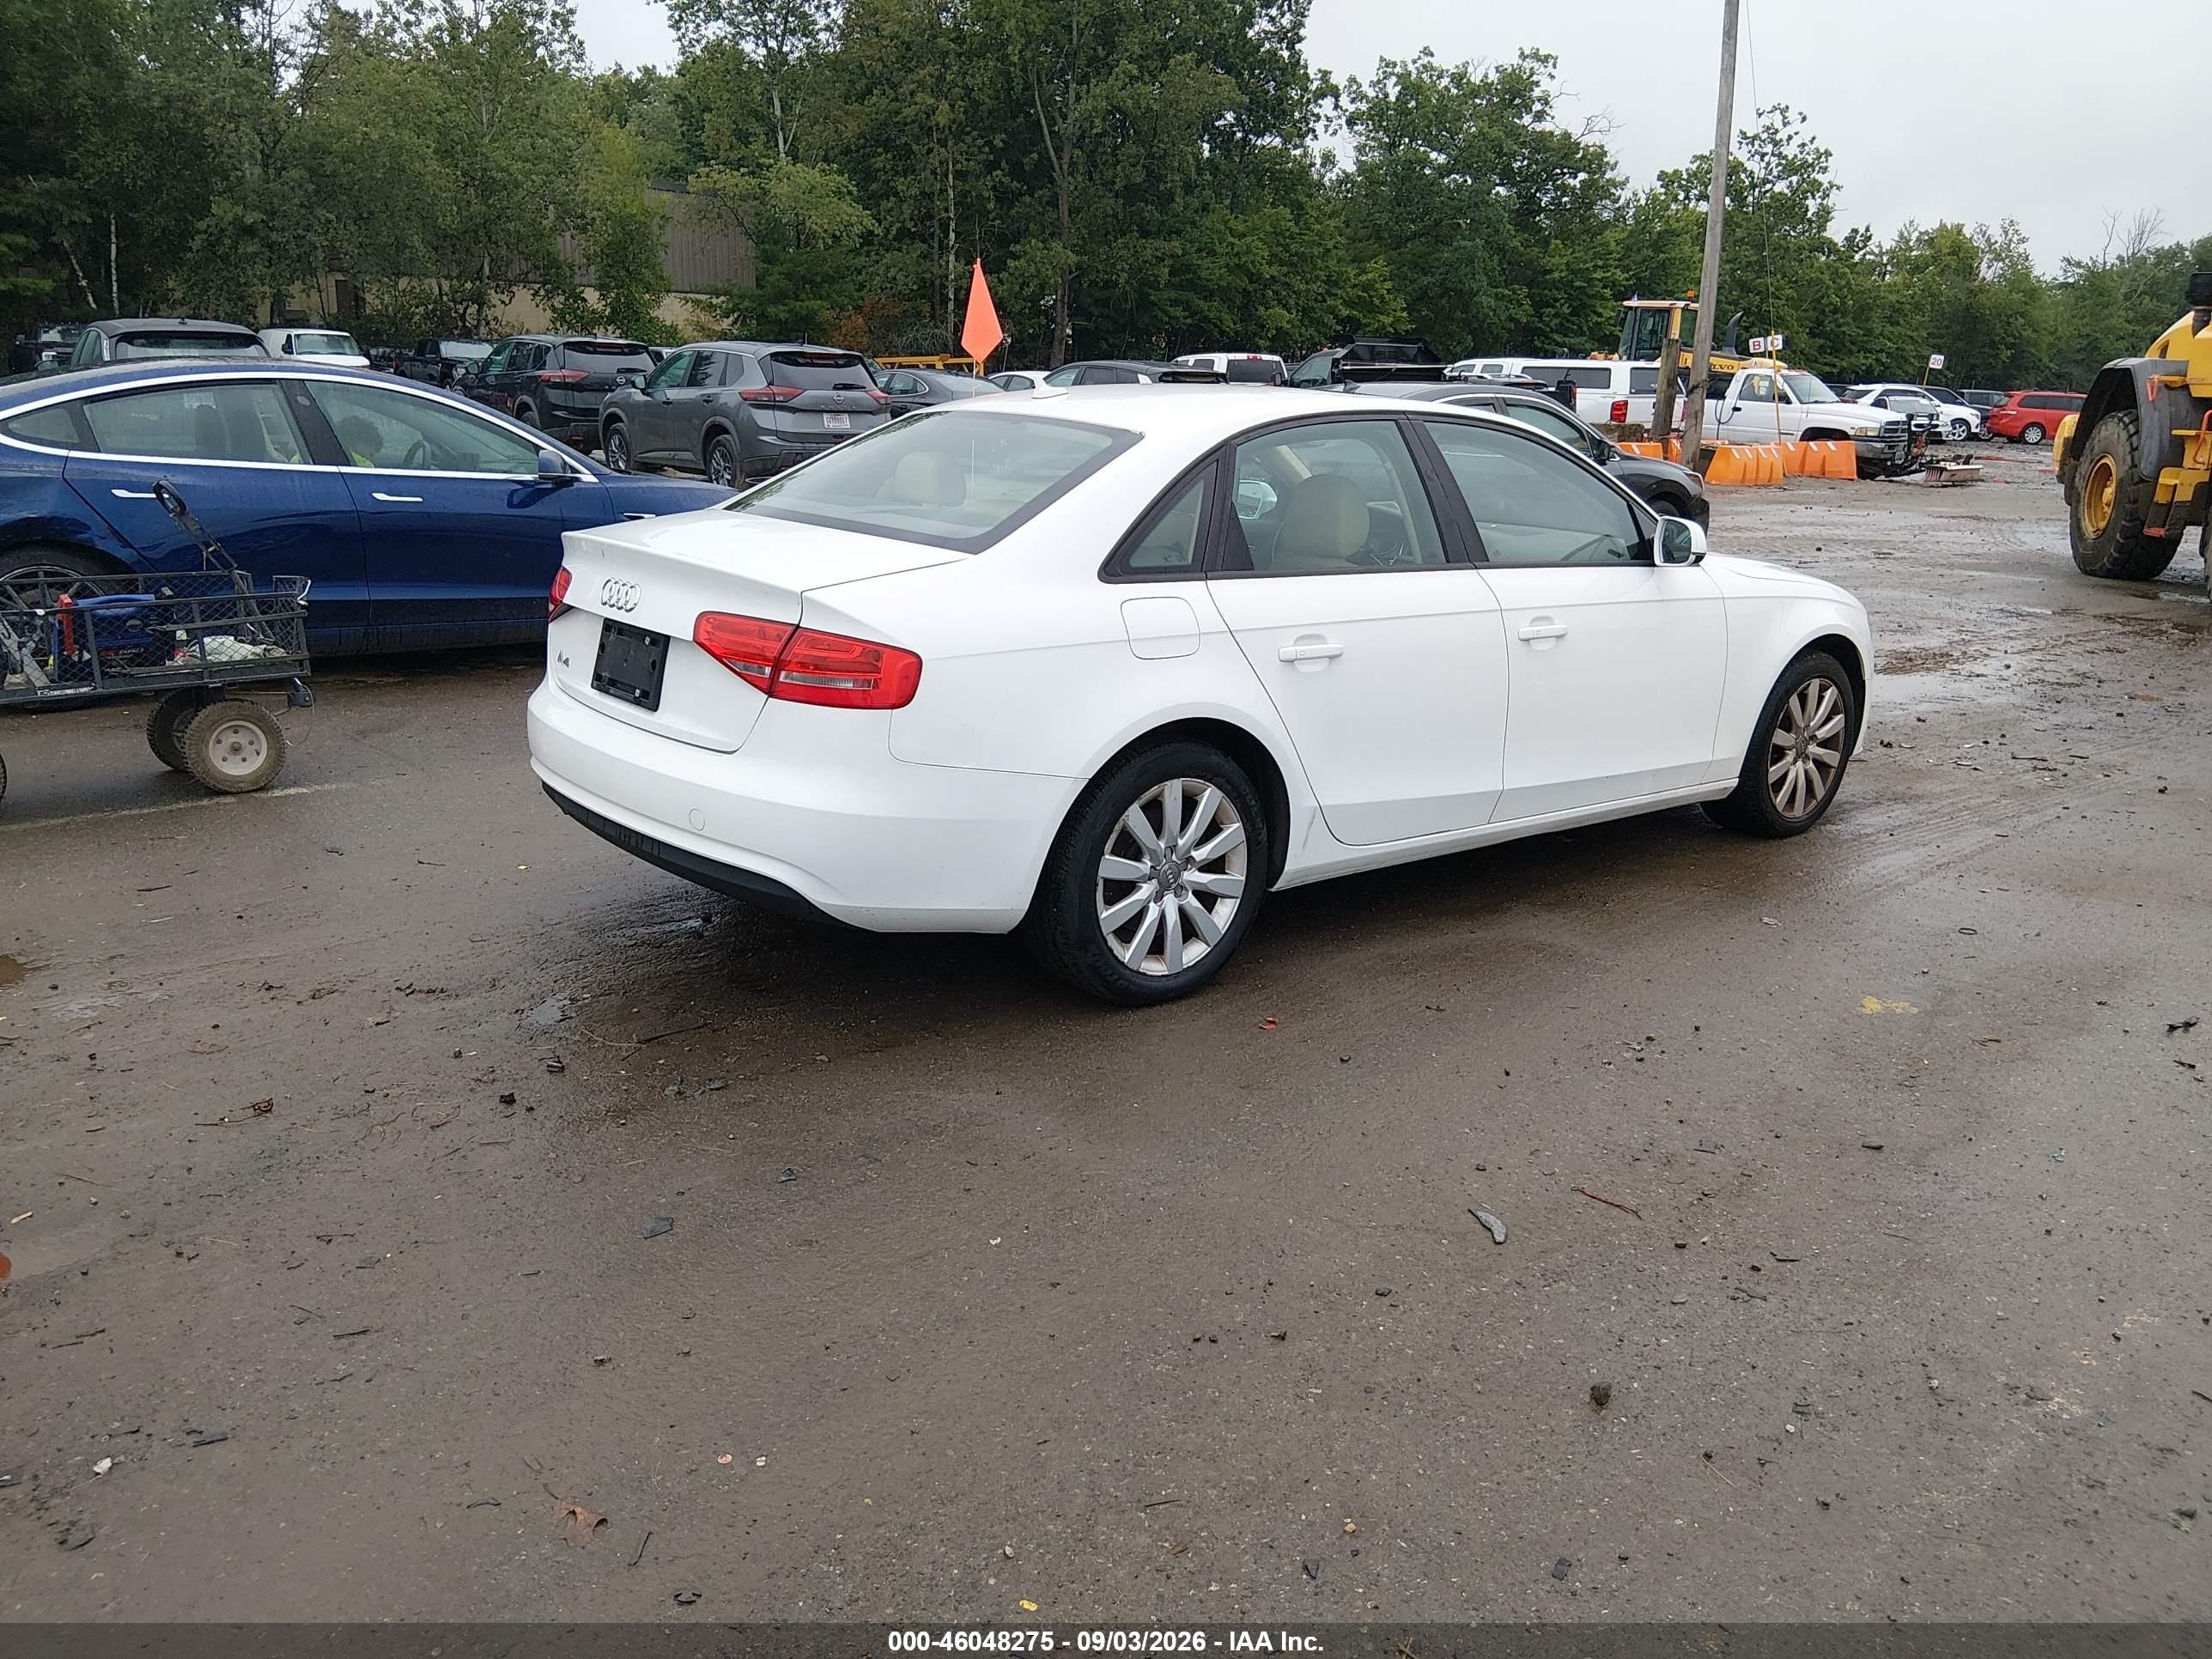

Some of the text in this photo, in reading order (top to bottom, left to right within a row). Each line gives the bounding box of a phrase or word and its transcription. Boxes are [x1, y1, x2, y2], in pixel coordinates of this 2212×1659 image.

[1753, 340, 1761, 350] B
[1771, 337, 1780, 348] C
[1931, 357, 1942, 366] 20
[556, 649, 569, 667] A4
